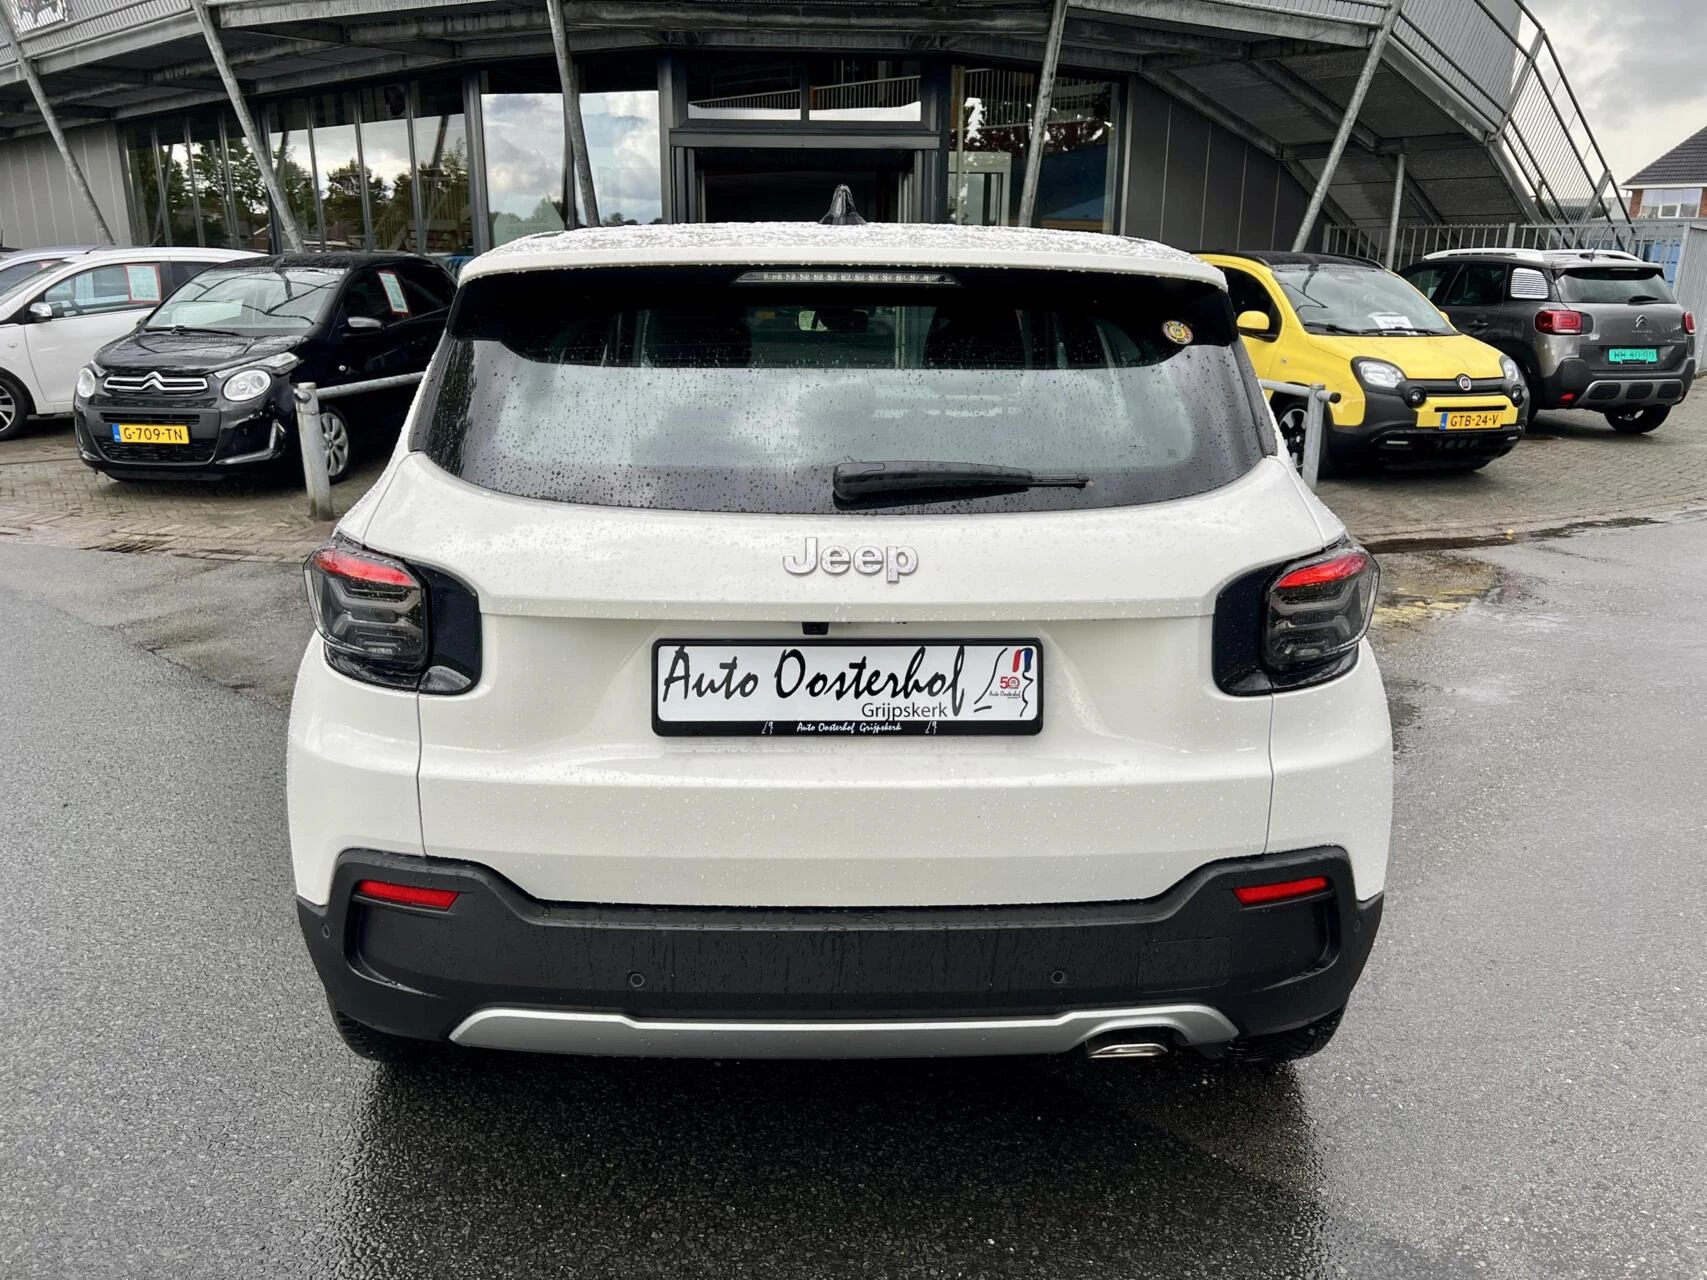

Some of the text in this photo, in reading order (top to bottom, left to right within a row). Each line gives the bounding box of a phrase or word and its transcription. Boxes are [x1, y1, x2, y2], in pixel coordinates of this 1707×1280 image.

[1450, 414, 1499, 427] GTB-24-V
[124, 427, 183, 441] G-709-TN
[783, 536, 919, 584] Jeep
[662, 645, 966, 717] Auto Oosterhof
[862, 702, 948, 720] Grijpskerk
[797, 722, 902, 734] Auto Oosterhof Grijpskerk
